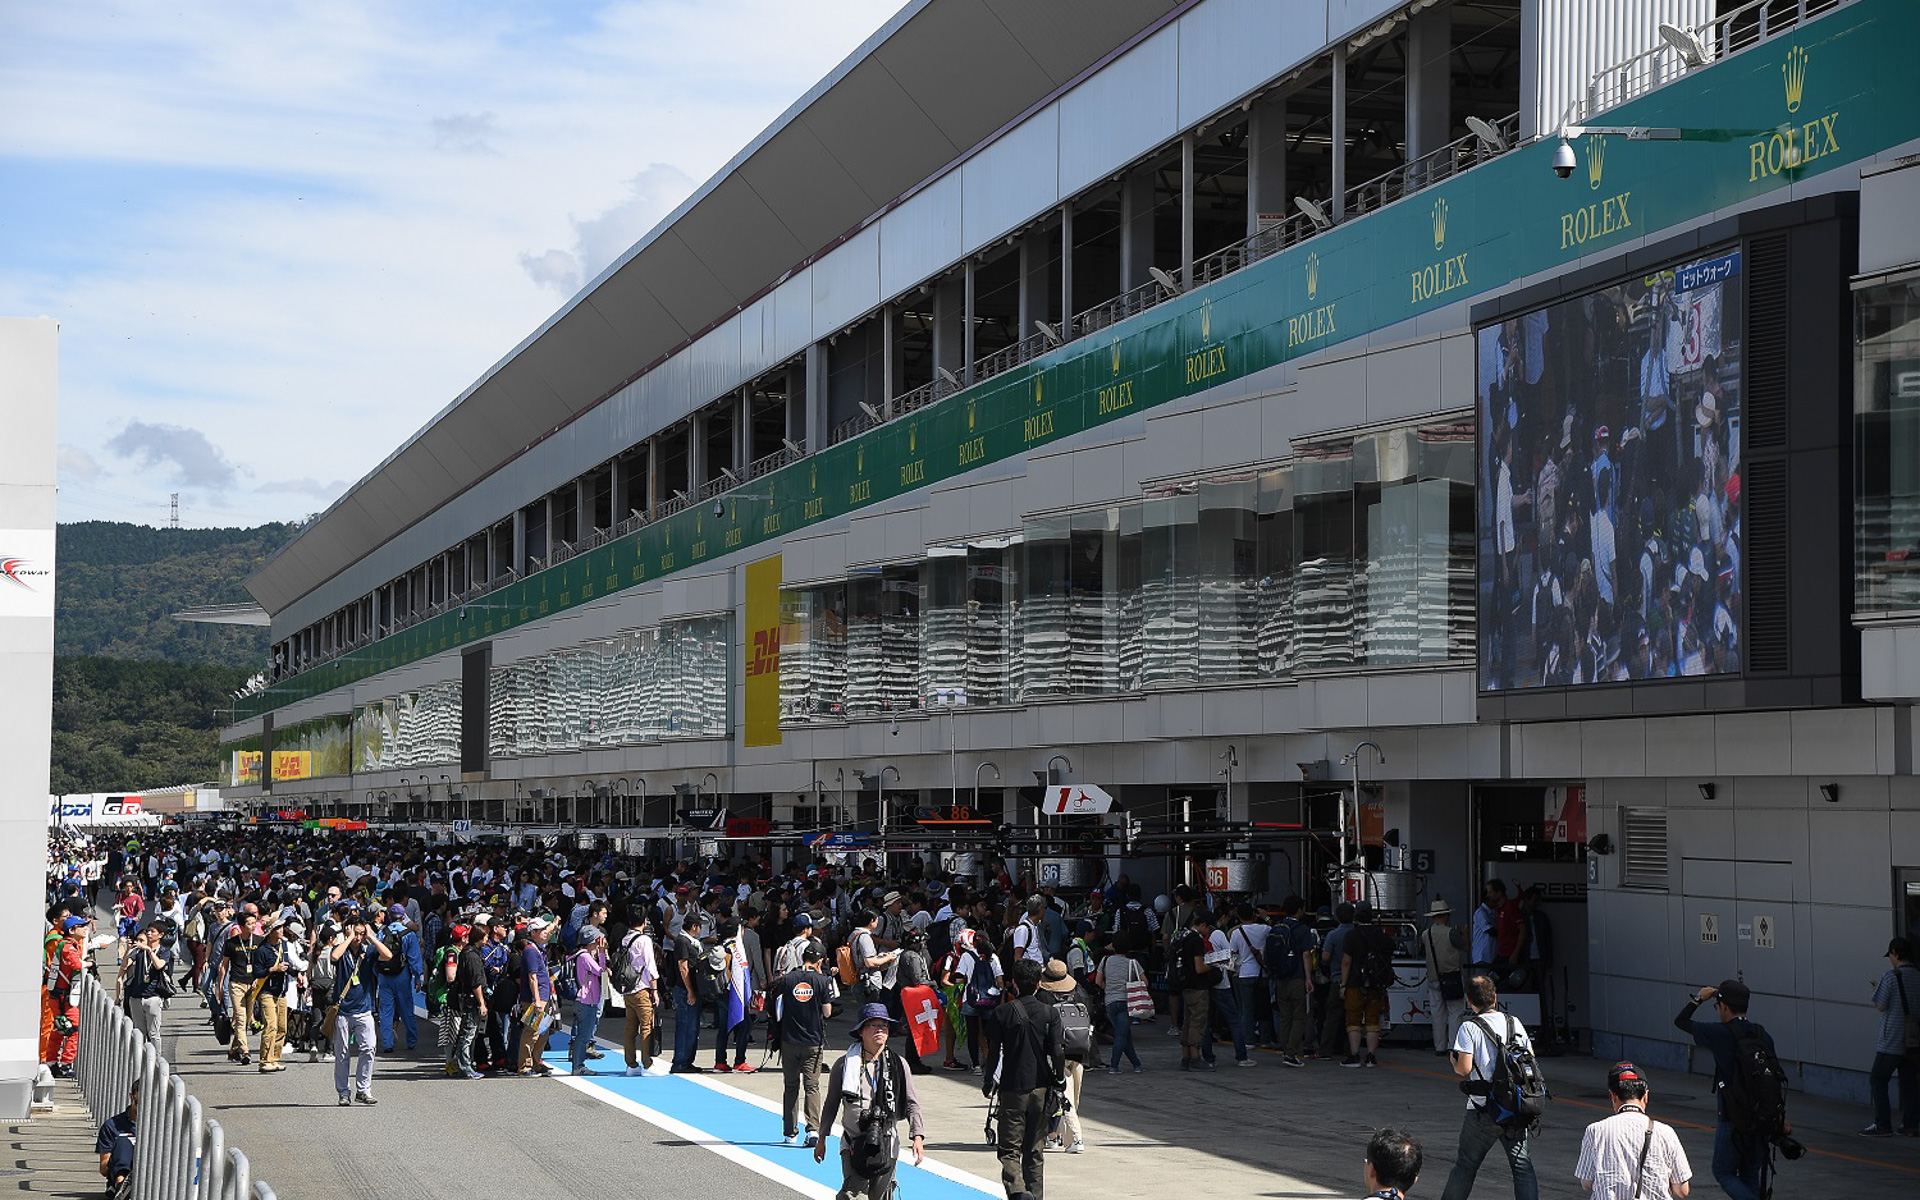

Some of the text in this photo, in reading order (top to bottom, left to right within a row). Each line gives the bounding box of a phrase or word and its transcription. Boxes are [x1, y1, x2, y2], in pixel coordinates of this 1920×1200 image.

[1749, 112, 1839, 183] ROLEX
[1561, 191, 1631, 249] ROLEX
[1411, 253, 1468, 304] ROLEX
[1289, 303, 1336, 347] ROLEX
[1187, 346, 1226, 385] ROLEX
[1099, 381, 1133, 415] ROLEX
[1024, 411, 1054, 443] ROLEX
[959, 436, 985, 466] ROLEX
[901, 459, 925, 486] ROLEX
[850, 479, 871, 505] ROLEX
[804, 497, 823, 520] ROLEX
[763, 513, 780, 535] ROLEX
[726, 527, 742, 549] ROLEX
[51, 804, 92, 816] KDDI
[103, 803, 141, 815] GR
[1056, 788, 1071, 812] 1
[284, 811, 296, 820] 92
[951, 806, 970, 820] 86
[835, 834, 854, 844] 36
[1043, 865, 1058, 880] 36
[1417, 852, 1429, 871] 5
[1589, 860, 1596, 880] 5
[1208, 869, 1224, 887] 86
